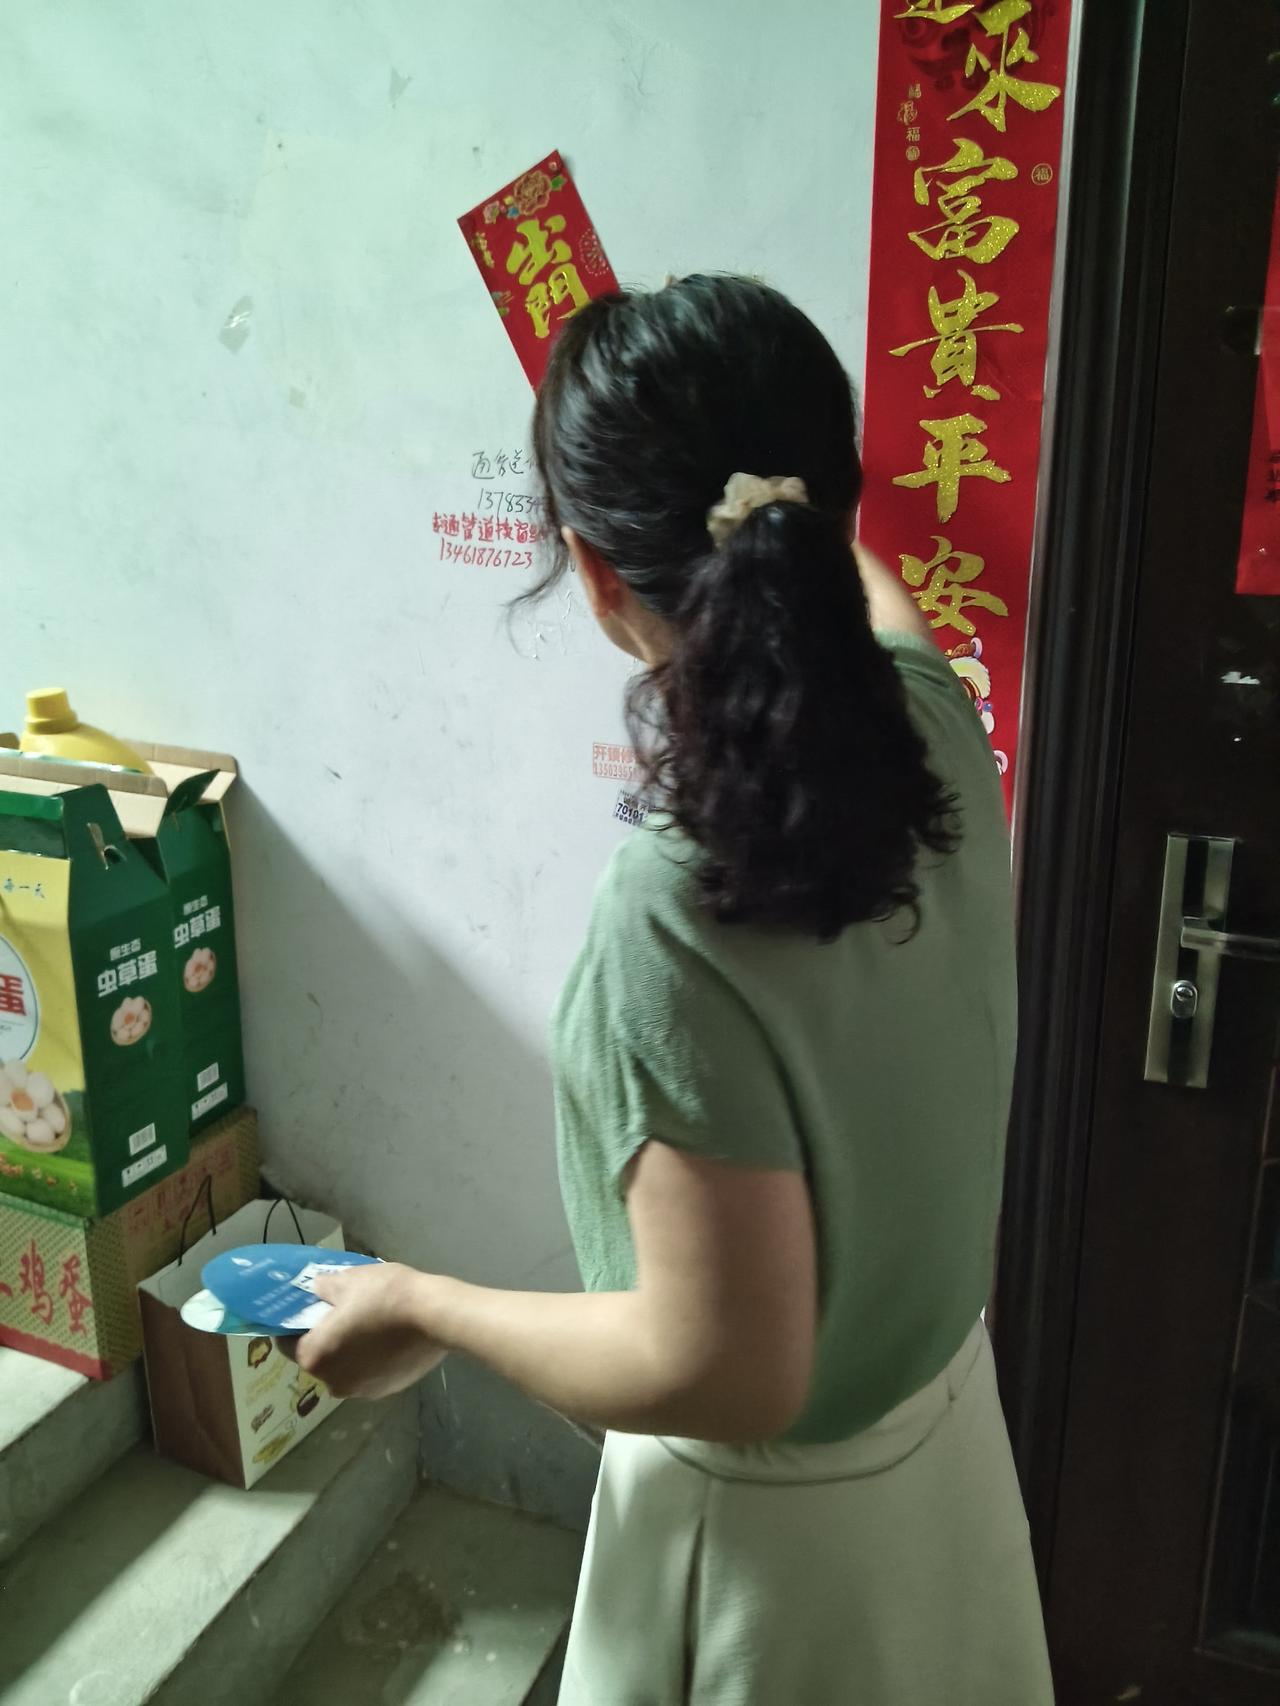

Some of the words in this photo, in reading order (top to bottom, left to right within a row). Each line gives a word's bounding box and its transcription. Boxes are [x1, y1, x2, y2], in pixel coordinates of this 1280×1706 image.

[440, 538, 533, 568] 13461876723
[174, 905, 221, 949] 虫草蛋
[97, 950, 158, 997] 虫草蛋
